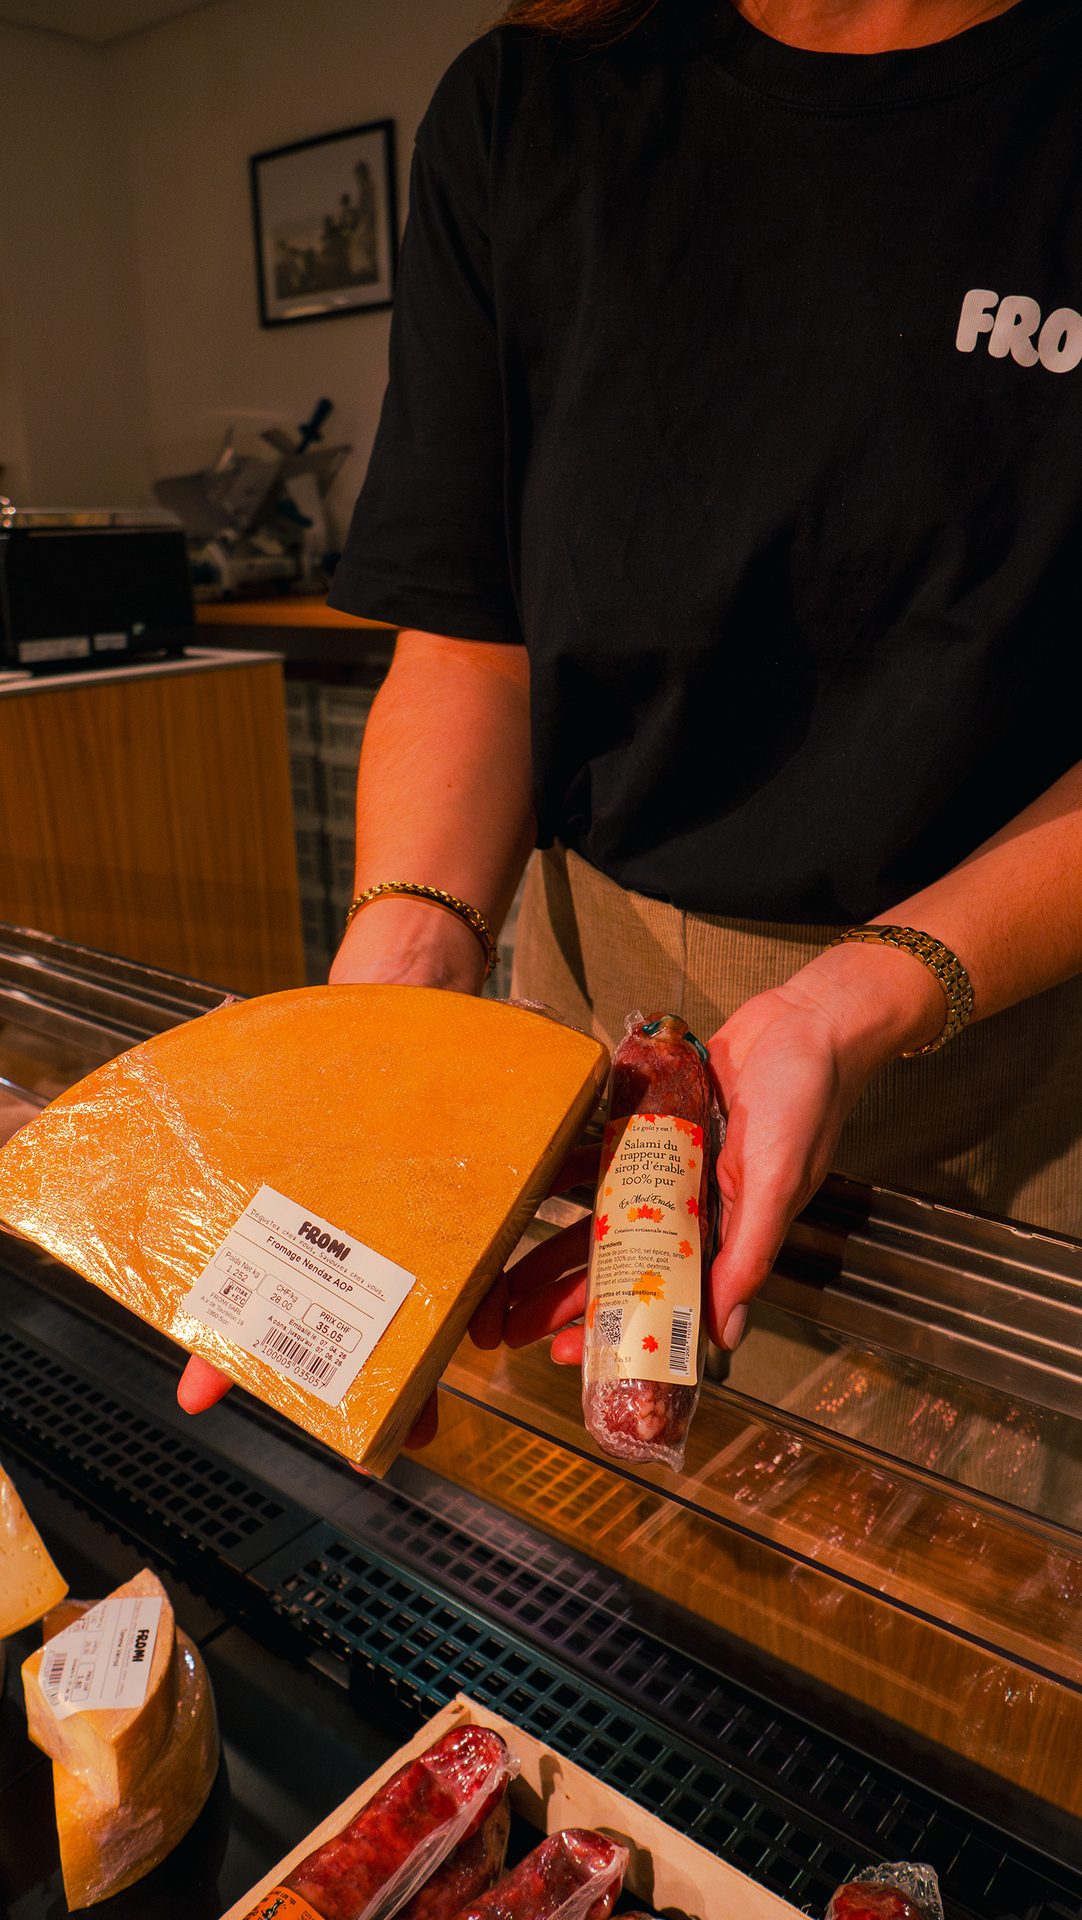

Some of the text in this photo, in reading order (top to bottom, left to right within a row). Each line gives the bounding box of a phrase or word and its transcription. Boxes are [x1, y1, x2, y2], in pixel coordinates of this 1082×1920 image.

[641, 1124, 655, 1132] goût
[624, 1139, 678, 1152] Salami du
[620, 1152, 681, 1163] trappeur au
[615, 1160, 686, 1176] sirop d'érable
[622, 1173, 676, 1187] 100% pur
[298, 1221, 351, 1261] FROMI
[266, 1236, 353, 1292] Fromage Nendaz AOP
[270, 1293, 293, 1311] 28.00
[319, 1311, 351, 1333] PRIX CHF
[316, 1321, 343, 1343] 35.05
[252, 1339, 259, 1348] 2
[131, 1629, 150, 1662] FROMI
